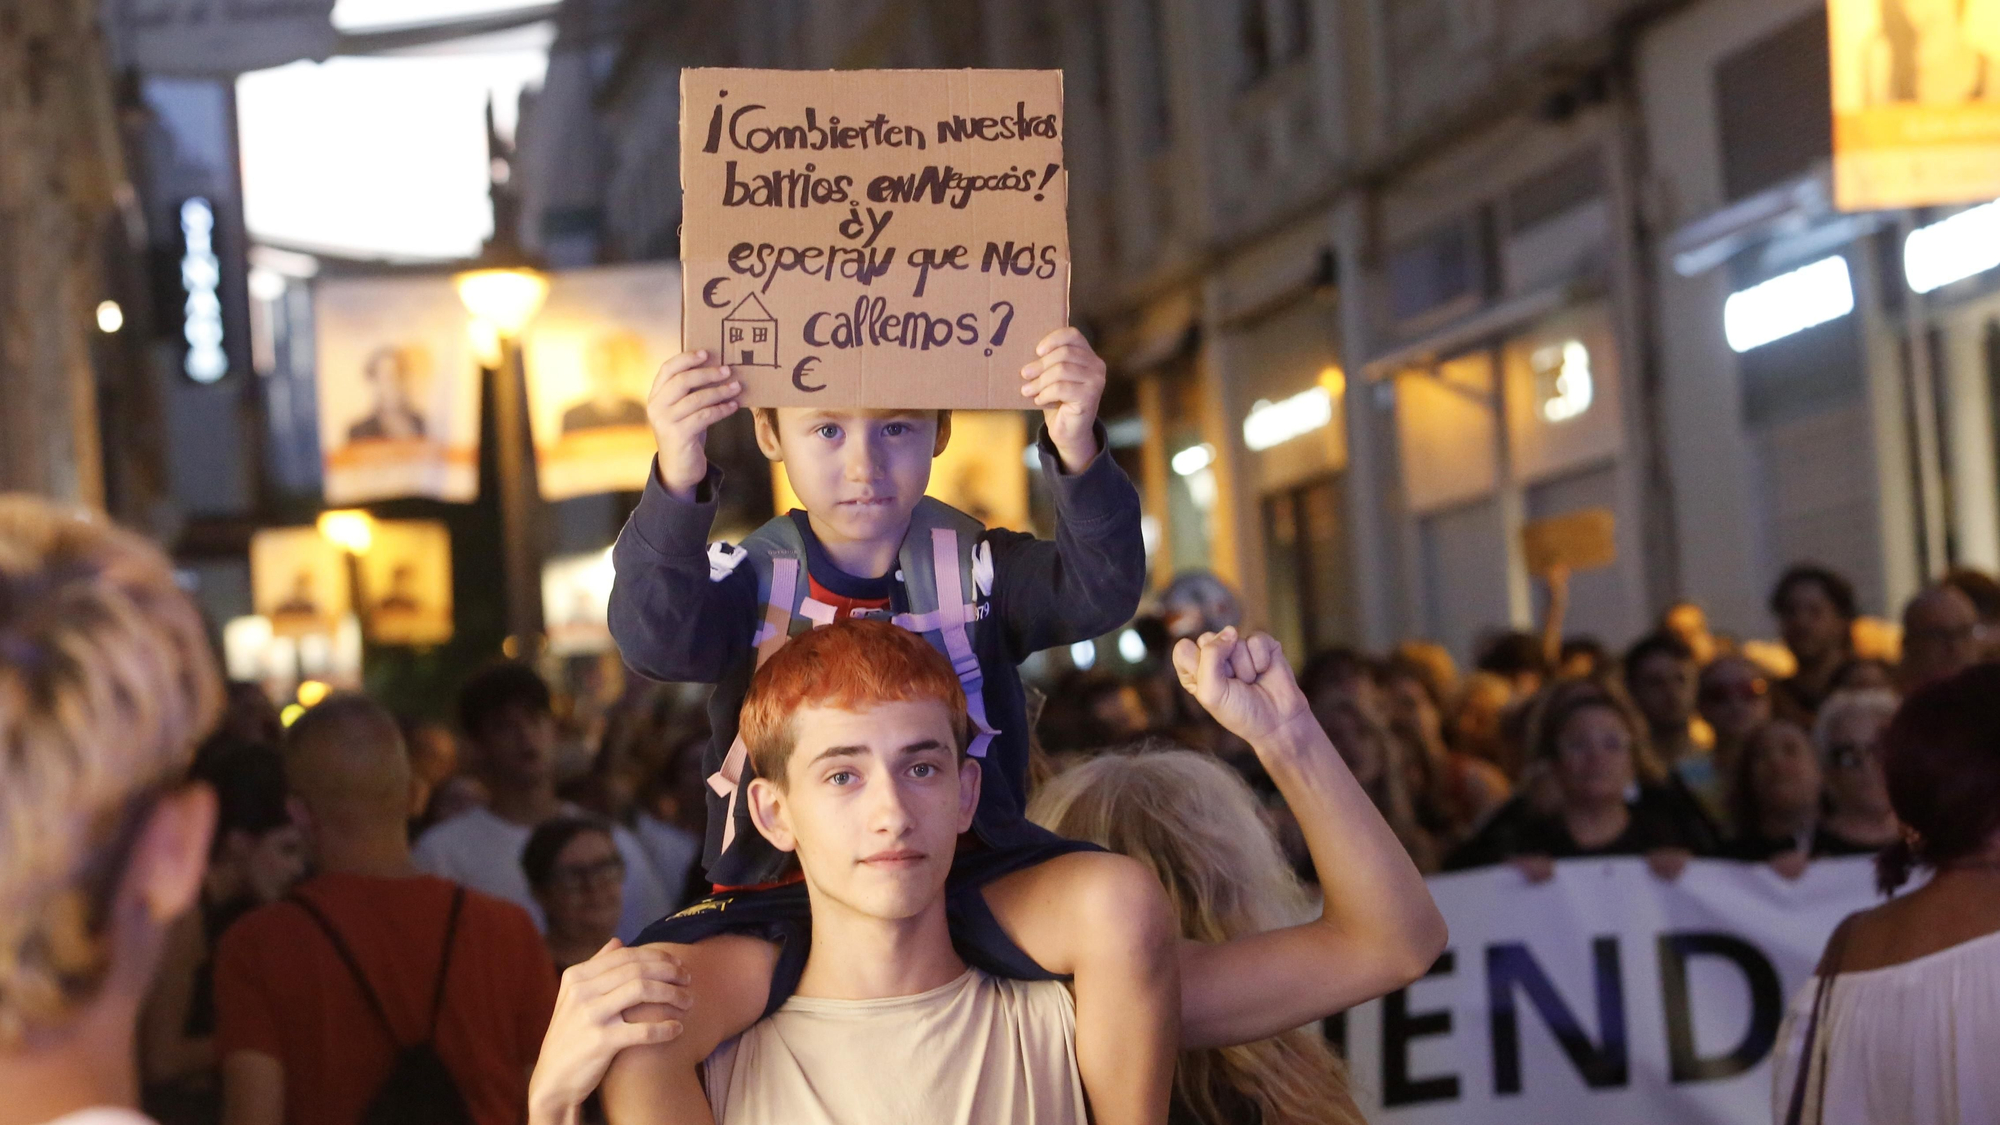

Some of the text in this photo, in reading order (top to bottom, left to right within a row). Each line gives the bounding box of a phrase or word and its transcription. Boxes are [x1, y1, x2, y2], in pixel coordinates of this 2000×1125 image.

[722, 160, 853, 208] barrios
[907, 245, 969, 298] que
[803, 295, 1014, 357] callemos?
